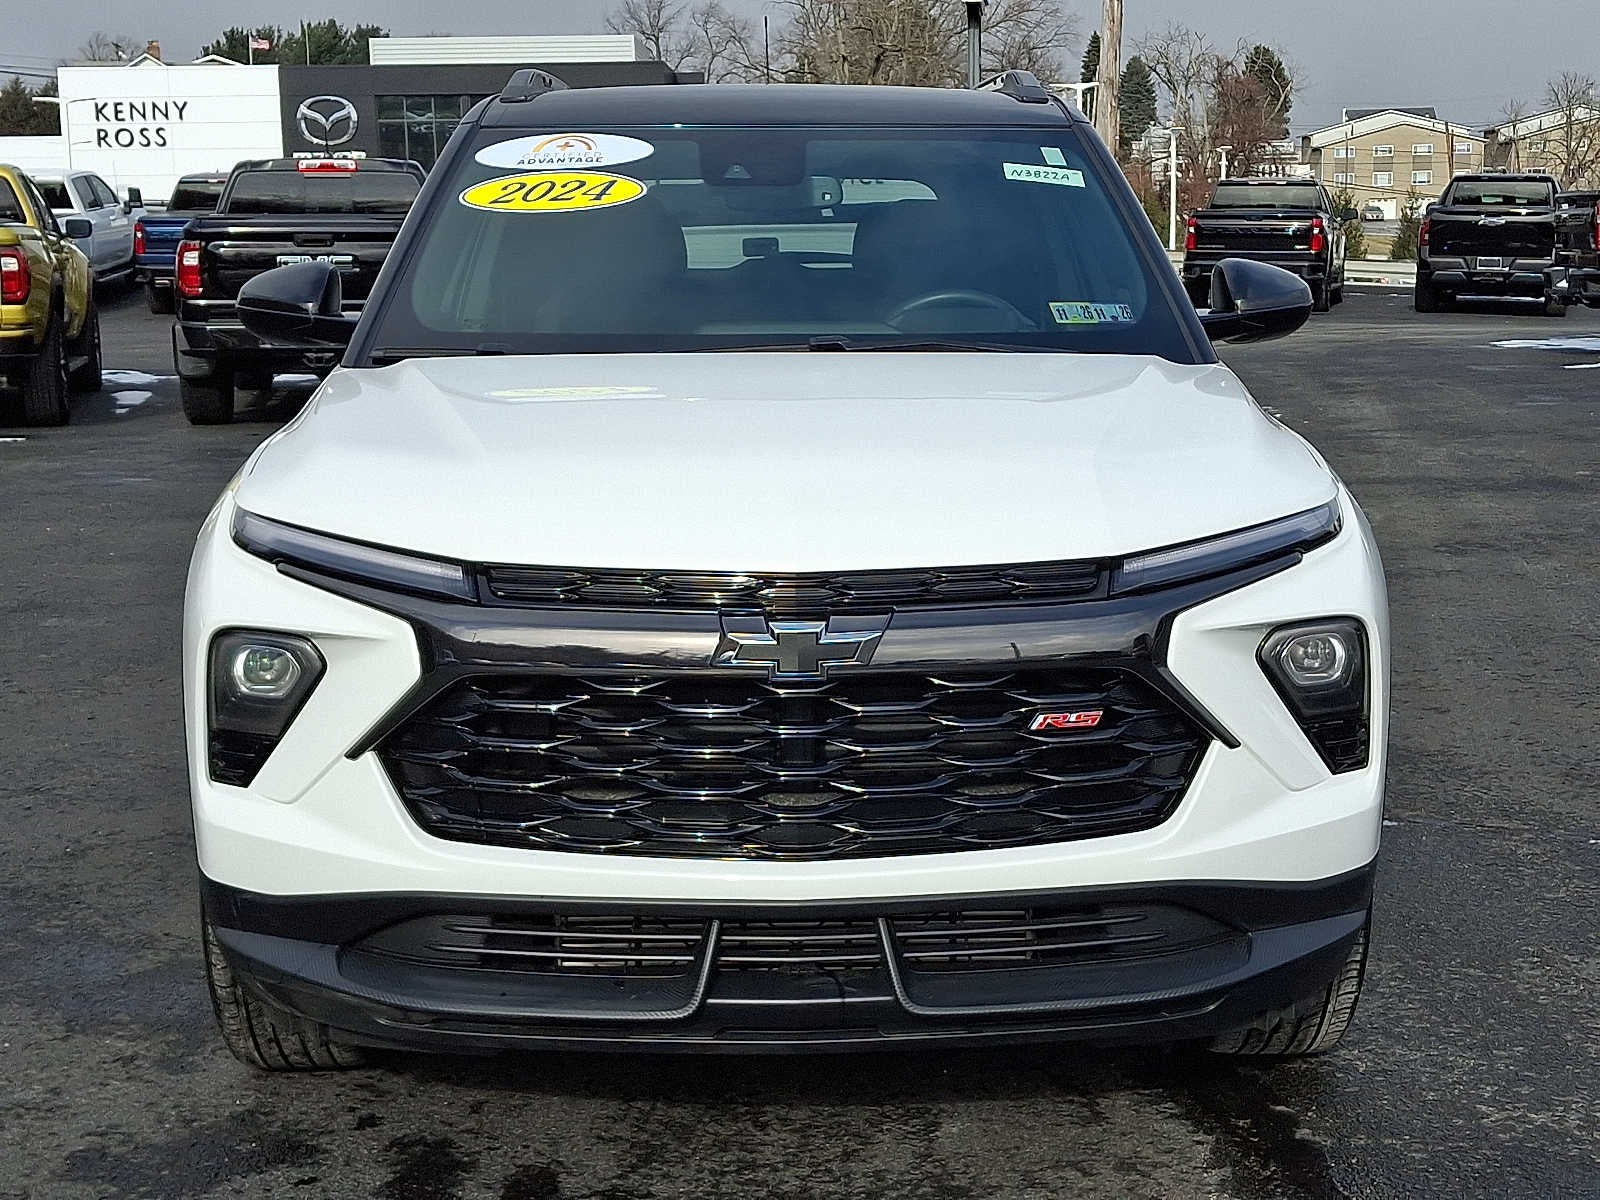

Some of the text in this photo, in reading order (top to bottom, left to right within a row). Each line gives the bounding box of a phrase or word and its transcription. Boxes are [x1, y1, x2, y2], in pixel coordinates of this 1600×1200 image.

[95, 101, 188, 122] KENNY
[97, 127, 168, 148] ROSS
[517, 157, 604, 165] ADVANTAGE
[522, 151, 603, 159] CERTIFIED
[489, 179, 618, 204] 2024
[1056, 304, 1095, 320] 11 26
[1093, 307, 1108, 320] 11
[1030, 711, 1103, 730] RS
